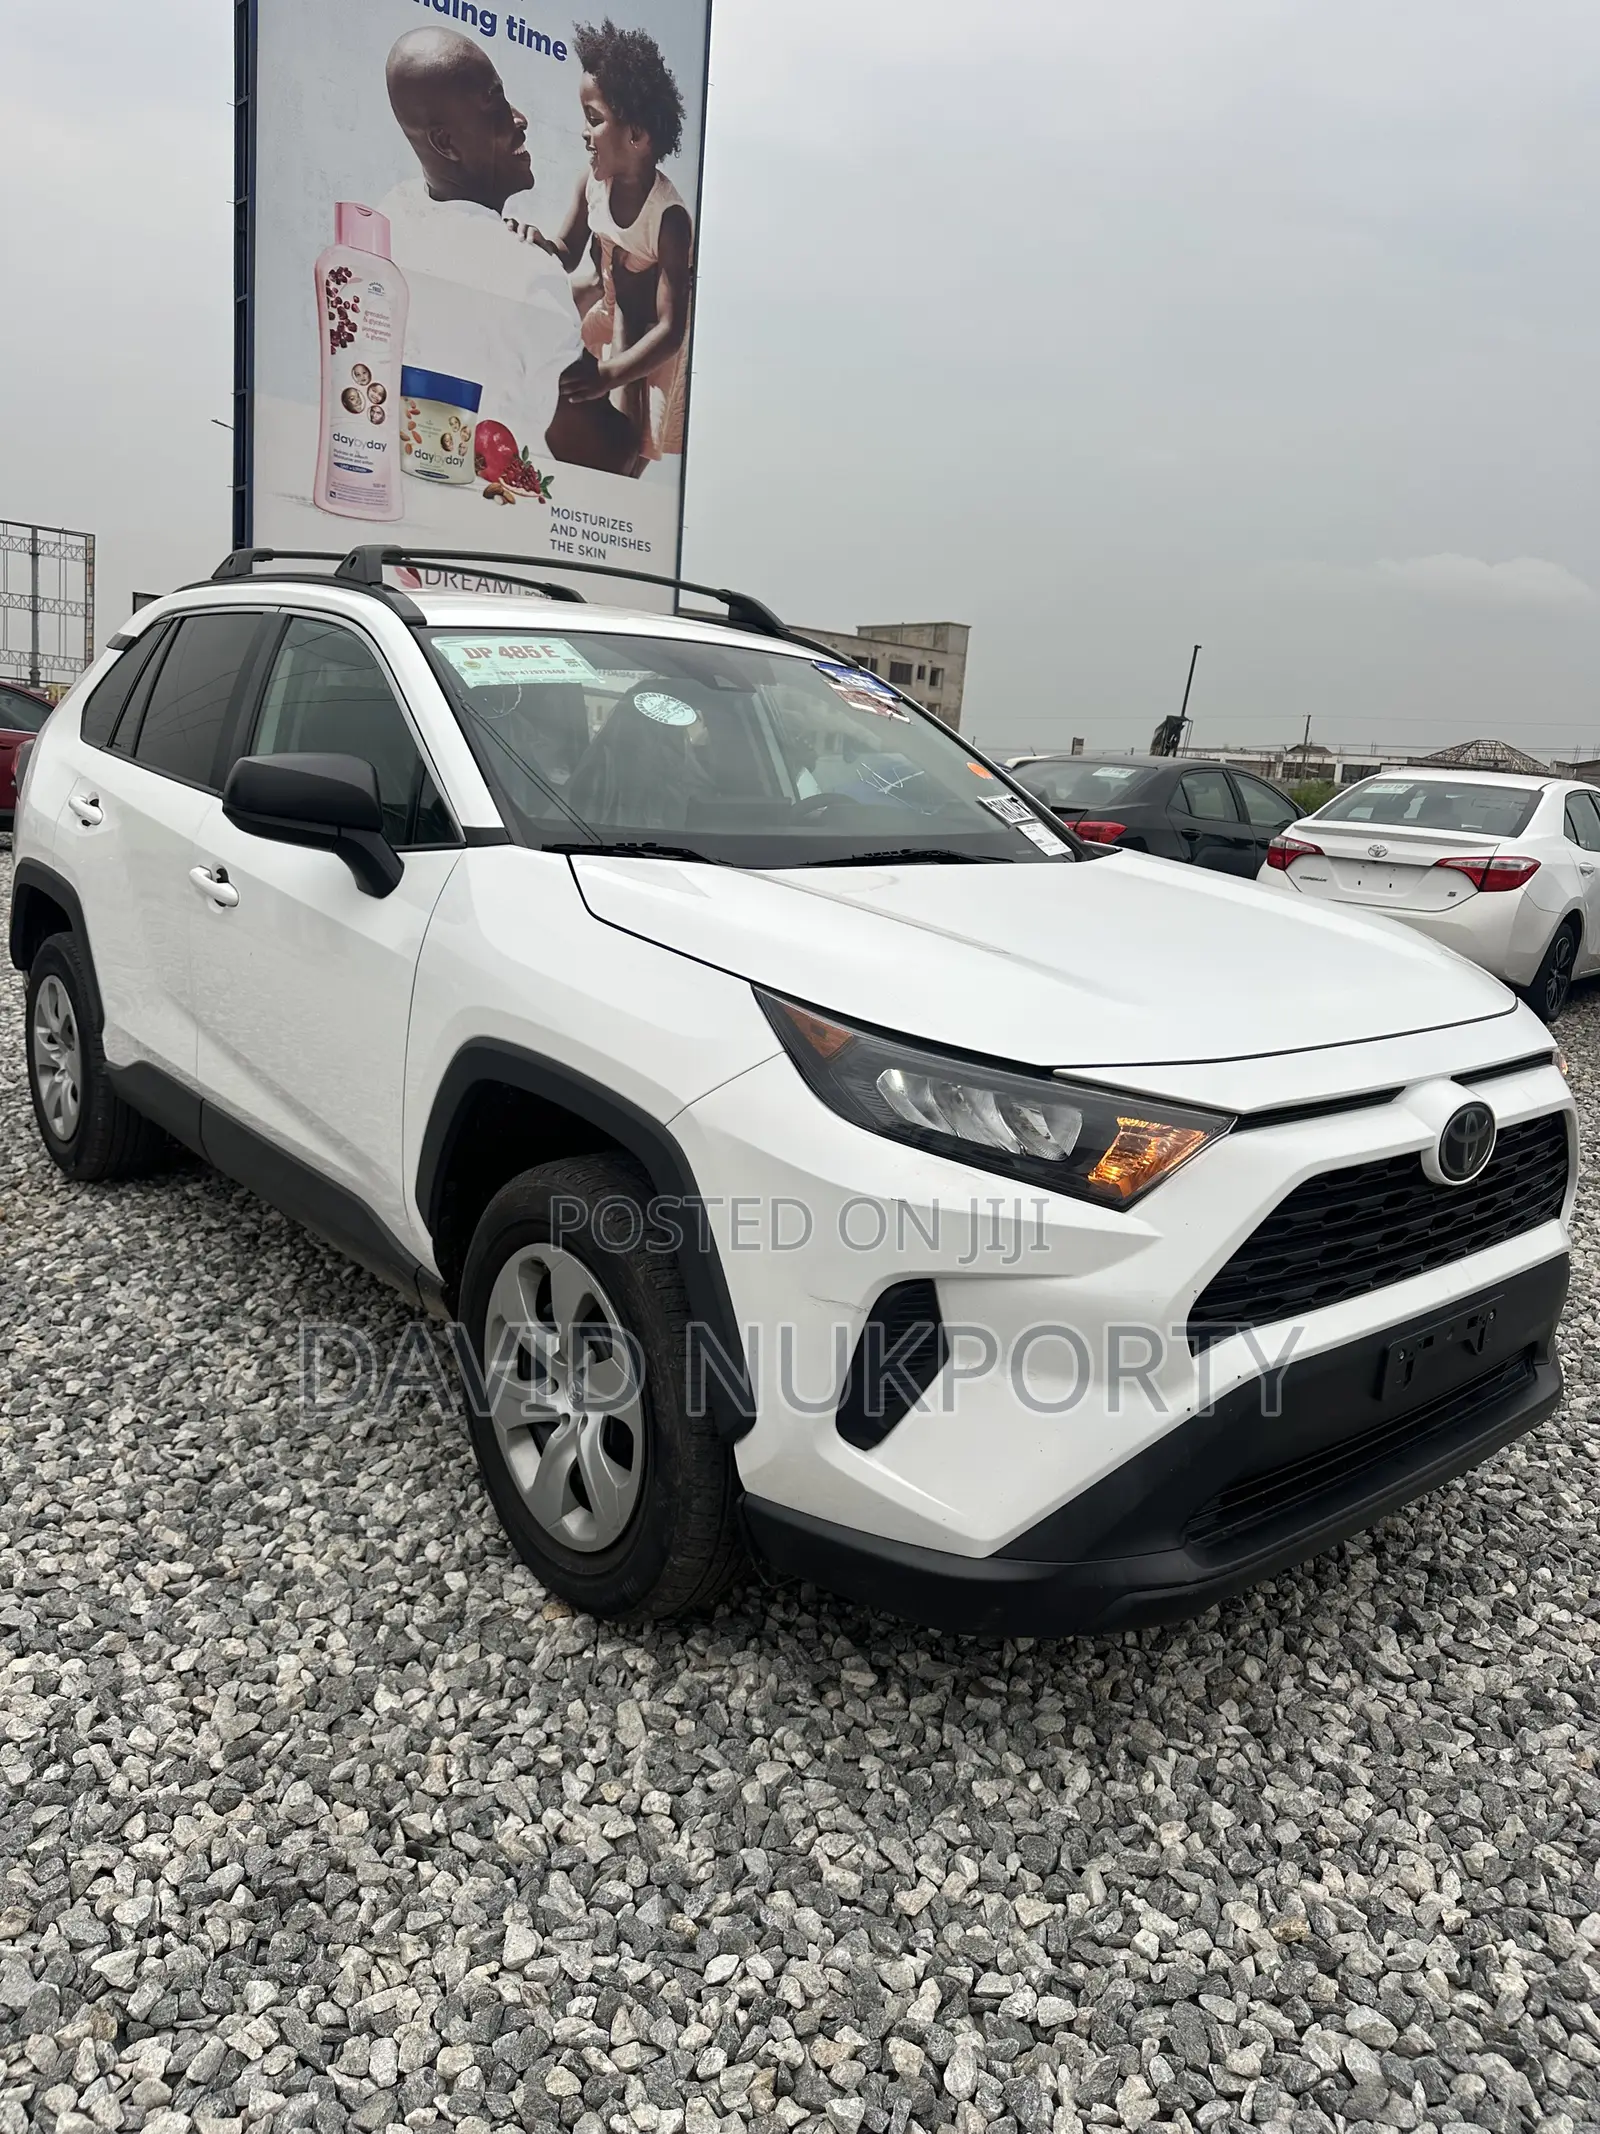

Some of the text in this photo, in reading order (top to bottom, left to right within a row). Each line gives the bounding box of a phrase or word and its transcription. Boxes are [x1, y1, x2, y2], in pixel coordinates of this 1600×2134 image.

[506, 14, 568, 61] time
[551, 506, 633, 533] MOISTURIZES
[549, 539, 606, 560] THE SKIN
[550, 523, 652, 552] AND NOURISHES
[425, 569, 513, 595] DREAM
[462, 645, 561, 659] DP 485 E
